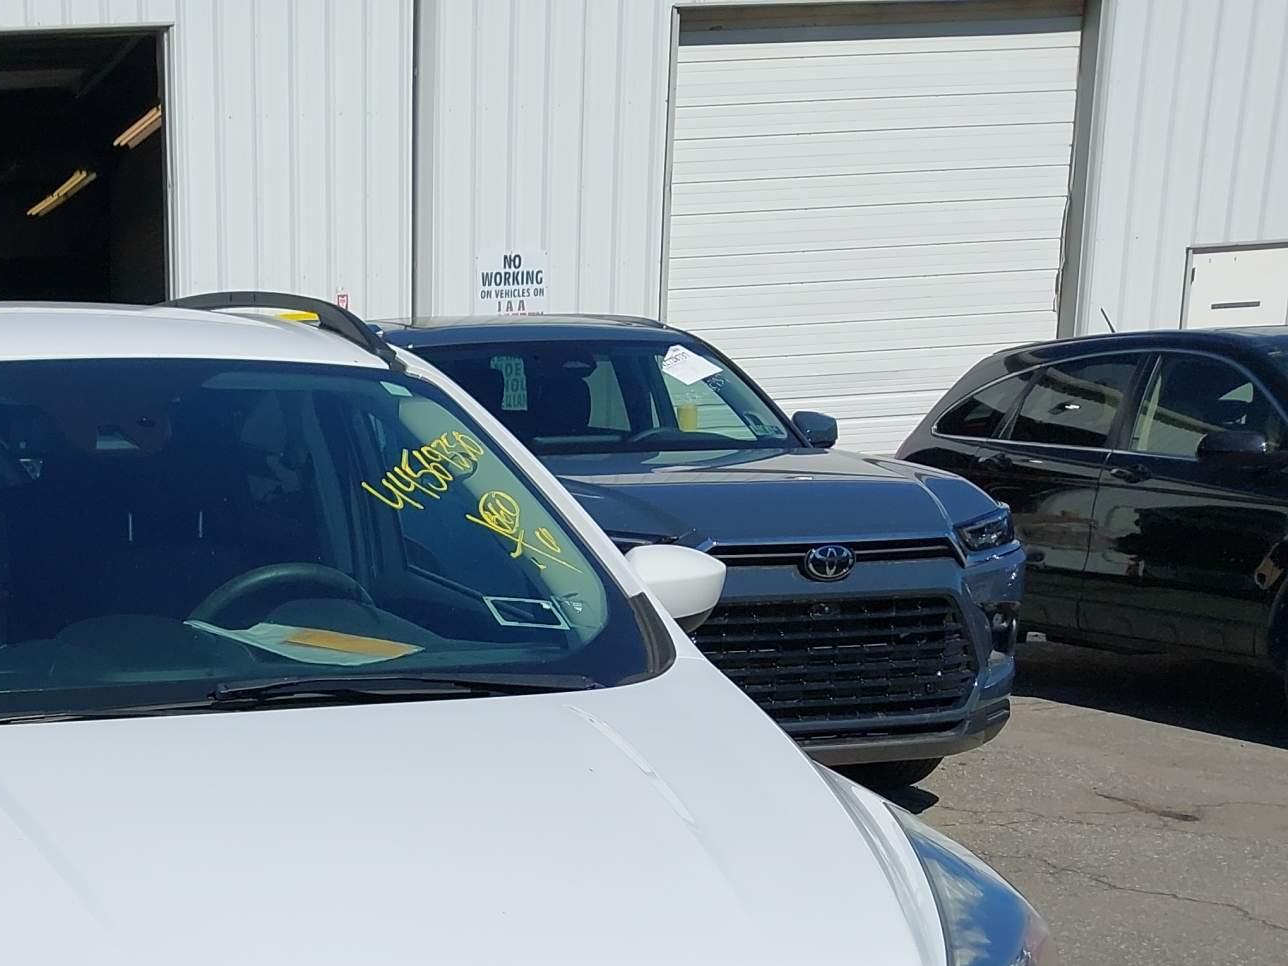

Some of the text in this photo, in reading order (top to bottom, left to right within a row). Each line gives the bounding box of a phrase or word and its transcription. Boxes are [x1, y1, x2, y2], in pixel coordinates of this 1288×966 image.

[503, 254, 522, 270] NO
[481, 270, 543, 287] WORKING
[480, 287, 545, 300] ON VEHICLES ON
